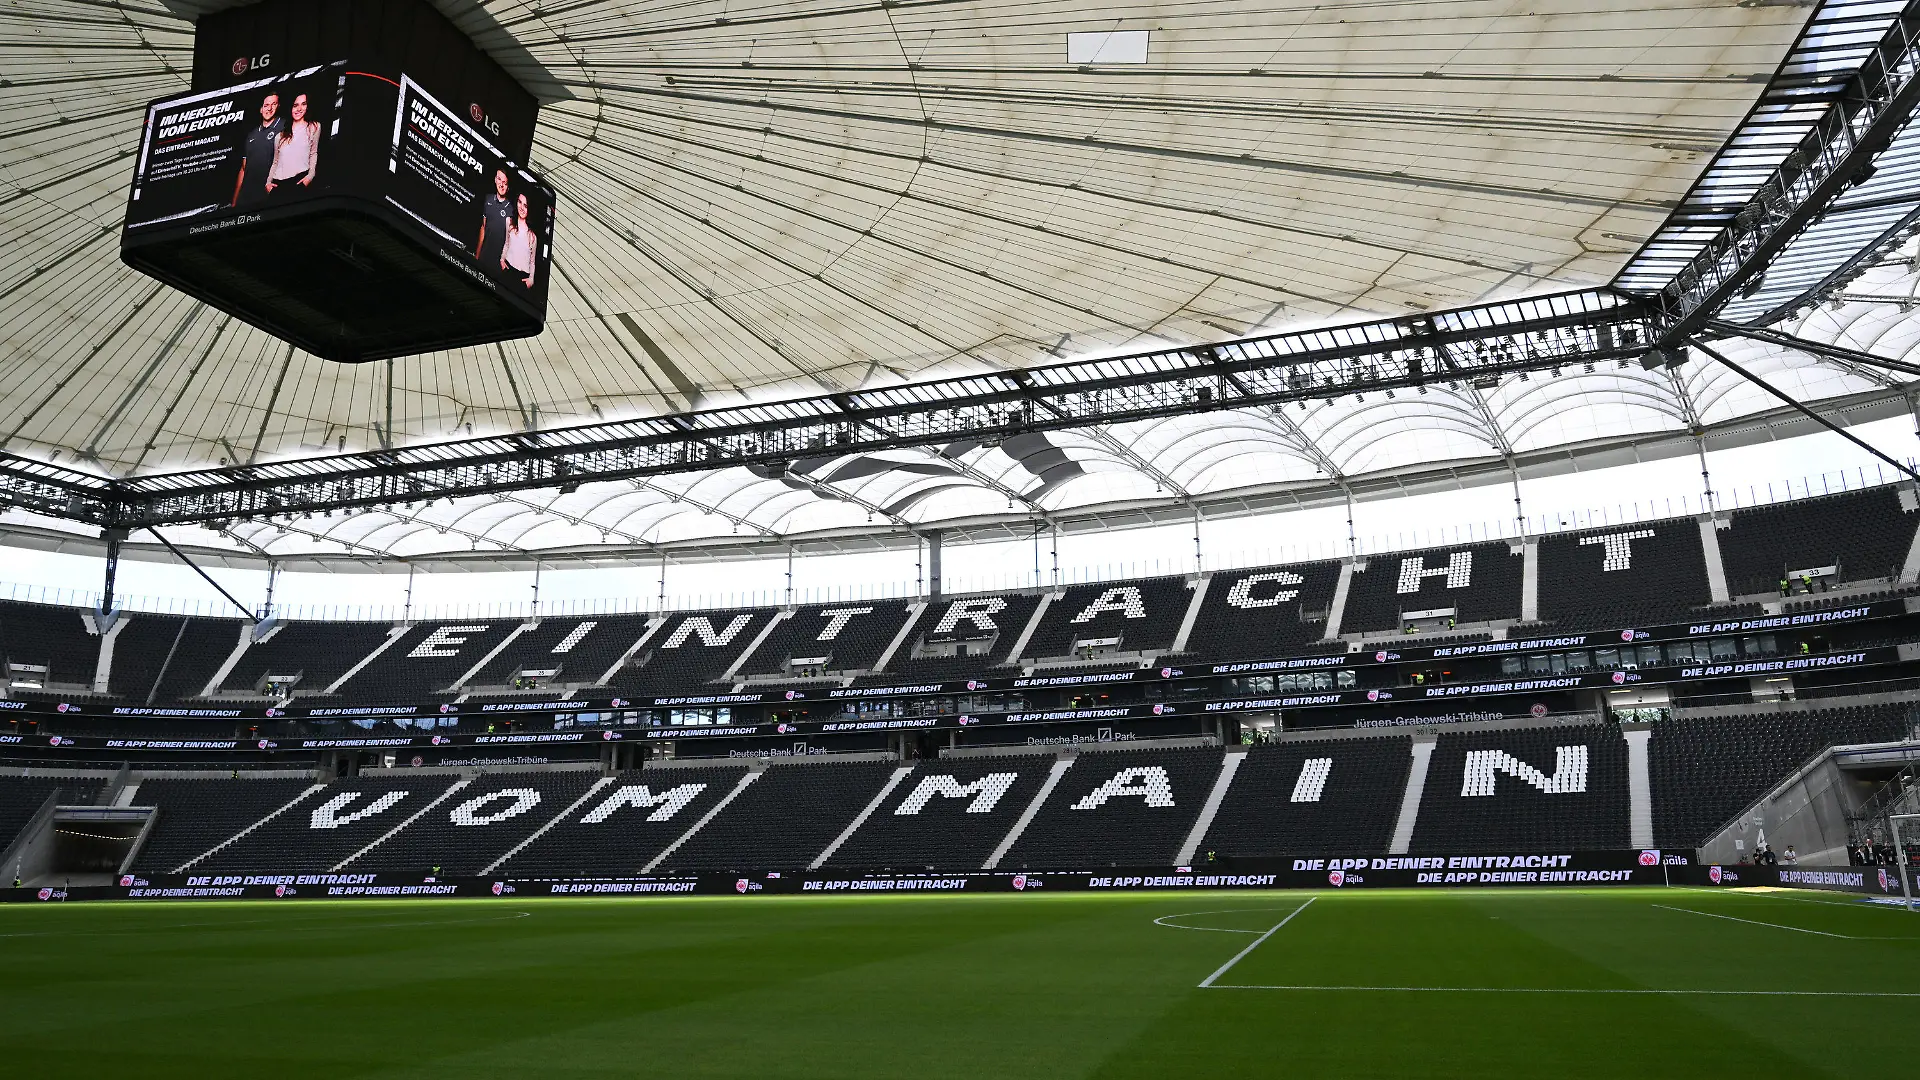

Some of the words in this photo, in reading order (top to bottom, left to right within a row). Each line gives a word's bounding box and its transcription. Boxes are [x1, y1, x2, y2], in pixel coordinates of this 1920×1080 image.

[250, 54, 270, 70] LG
[160, 114, 178, 126] IM
[178, 101, 233, 122] HERZEN
[159, 123, 189, 138] VON
[189, 110, 244, 132] EUROPA
[411, 99, 428, 117] IM
[428, 112, 474, 153] HERZEN
[485, 114, 499, 136] LG
[154, 147, 165, 155] DAS
[166, 140, 195, 153] EINTRACHT
[195, 135, 220, 146] MAGAZIN
[411, 111, 438, 138] VON
[438, 132, 482, 174] EUROPA
[190, 223, 219, 234] Deutsche
[220, 219, 236, 228] Bank
[247, 215, 261, 223] Park
[441, 249, 464, 270] Deutsche
[465, 265, 477, 278] Bank
[407, 529, 1655, 657] EINTRACHT
[1690, 625, 1710, 634] DIE
[1712, 622, 1739, 632] APP
[1742, 617, 1790, 629] DEINER
[1792, 607, 1870, 624] EINTRACHT
[1434, 648, 1452, 656] DIE
[1453, 646, 1476, 654] APP
[1478, 642, 1518, 652] DEINER
[1520, 636, 1586, 649] EINTRACHT
[1251, 661, 1287, 670] DEINER
[1288, 657, 1346, 667] EINTRACHT
[1682, 668, 1703, 677] DIE
[1705, 666, 1732, 675] APP
[1735, 662, 1784, 672] DEINER
[1786, 653, 1866, 668] EINTRACHT
[1081, 673, 1134, 682] EINTRACHT
[894, 685, 942, 693] EINTRACHT
[1426, 688, 1445, 696] DIE
[1446, 686, 1470, 695] APP
[1471, 683, 1512, 693] DEINER
[1514, 678, 1581, 690] EINTRACHT
[1245, 699, 1281, 708] DEINER
[1282, 695, 1341, 706] EINTRACHT
[1077, 709, 1130, 718] EINTRACHT
[1354, 711, 1503, 729] Jürgen-Grabowski-Tribüne
[888, 719, 937, 727] EINTRACHT
[1028, 735, 1070, 745] Deutsche
[1072, 734, 1095, 743] Bank
[1114, 732, 1136, 741] Park
[729, 749, 768, 758] Deutsche
[770, 748, 791, 757] Bank
[808, 746, 827, 755] Park
[439, 756, 547, 766] Jürgen-Grabowski-Tribüne
[894, 745, 1588, 814] MAIN
[1293, 860, 1324, 870] DIE
[1327, 859, 1368, 870] APP
[1371, 857, 1445, 869] DEINER
[1448, 855, 1571, 868] EINTRACHT
[186, 877, 211, 885] DIE
[212, 876, 242, 885] APP
[243, 876, 295, 886] DEINER
[296, 874, 376, 884] EINTRACHT
[1089, 878, 1112, 886] DIE
[1113, 877, 1142, 886] APP
[1144, 876, 1194, 886] DEINER
[1196, 875, 1276, 885] EINTRACHT
[1417, 873, 1442, 882] DIE
[1444, 872, 1477, 882] APP
[1480, 872, 1537, 882] DEINER
[1540, 870, 1633, 881] EINTRACHT
[1780, 871, 1789, 882] DIE
[1790, 871, 1801, 882] APP
[1802, 872, 1824, 884] DEINER
[1823, 872, 1863, 886] EINTRACHT
[194, 888, 244, 896] EINTRACHT
[401, 886, 457, 894] EINTRACHT
[570, 884, 592, 892] APP
[593, 884, 632, 892] DEINER
[633, 883, 696, 892] EINTRACHT
[803, 881, 823, 890] DIE
[824, 881, 849, 890] APP
[850, 880, 895, 889] DEINER
[896, 880, 967, 889] EINTRACHT
